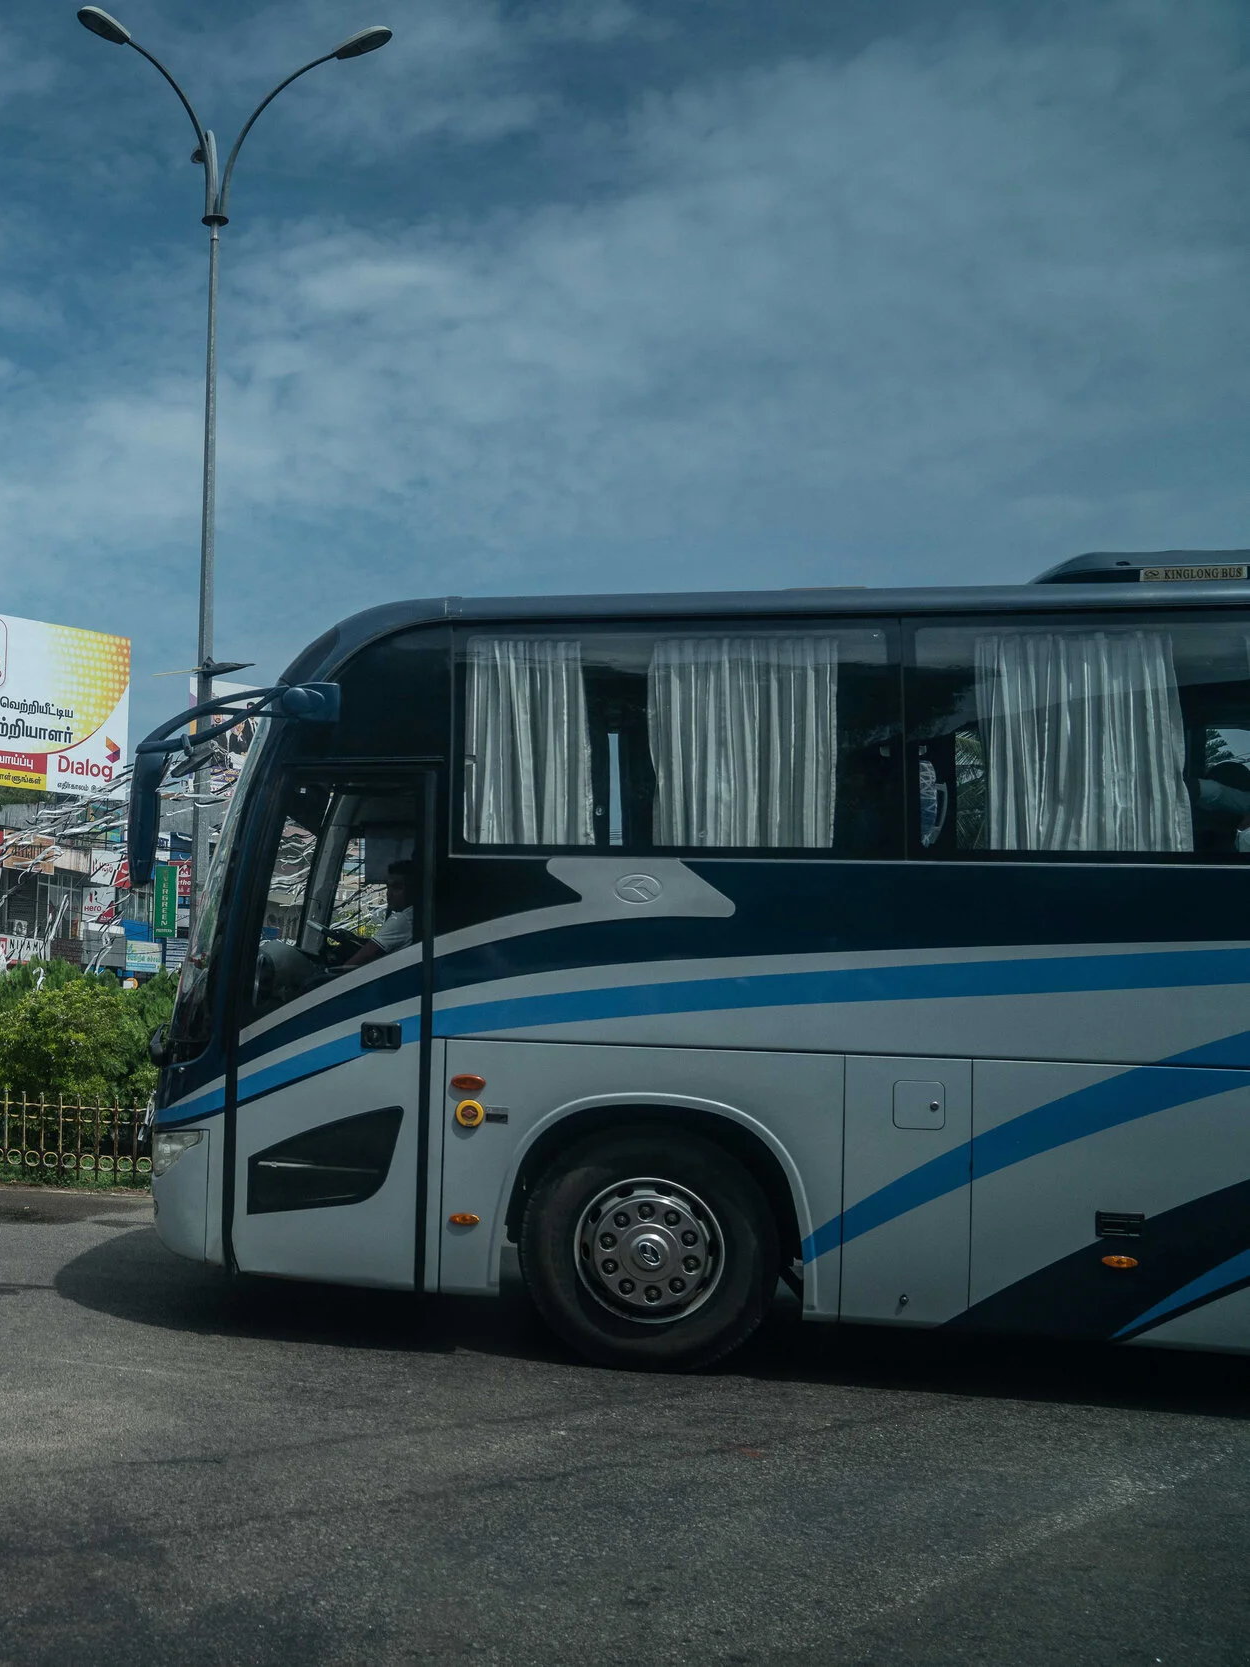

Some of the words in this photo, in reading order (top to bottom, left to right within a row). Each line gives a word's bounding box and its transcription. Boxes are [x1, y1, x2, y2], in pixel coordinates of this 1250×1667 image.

[1164, 567, 1221, 580] KINGLONG
[1221, 566, 1243, 578] BUS
[58, 755, 113, 782] Dialog
